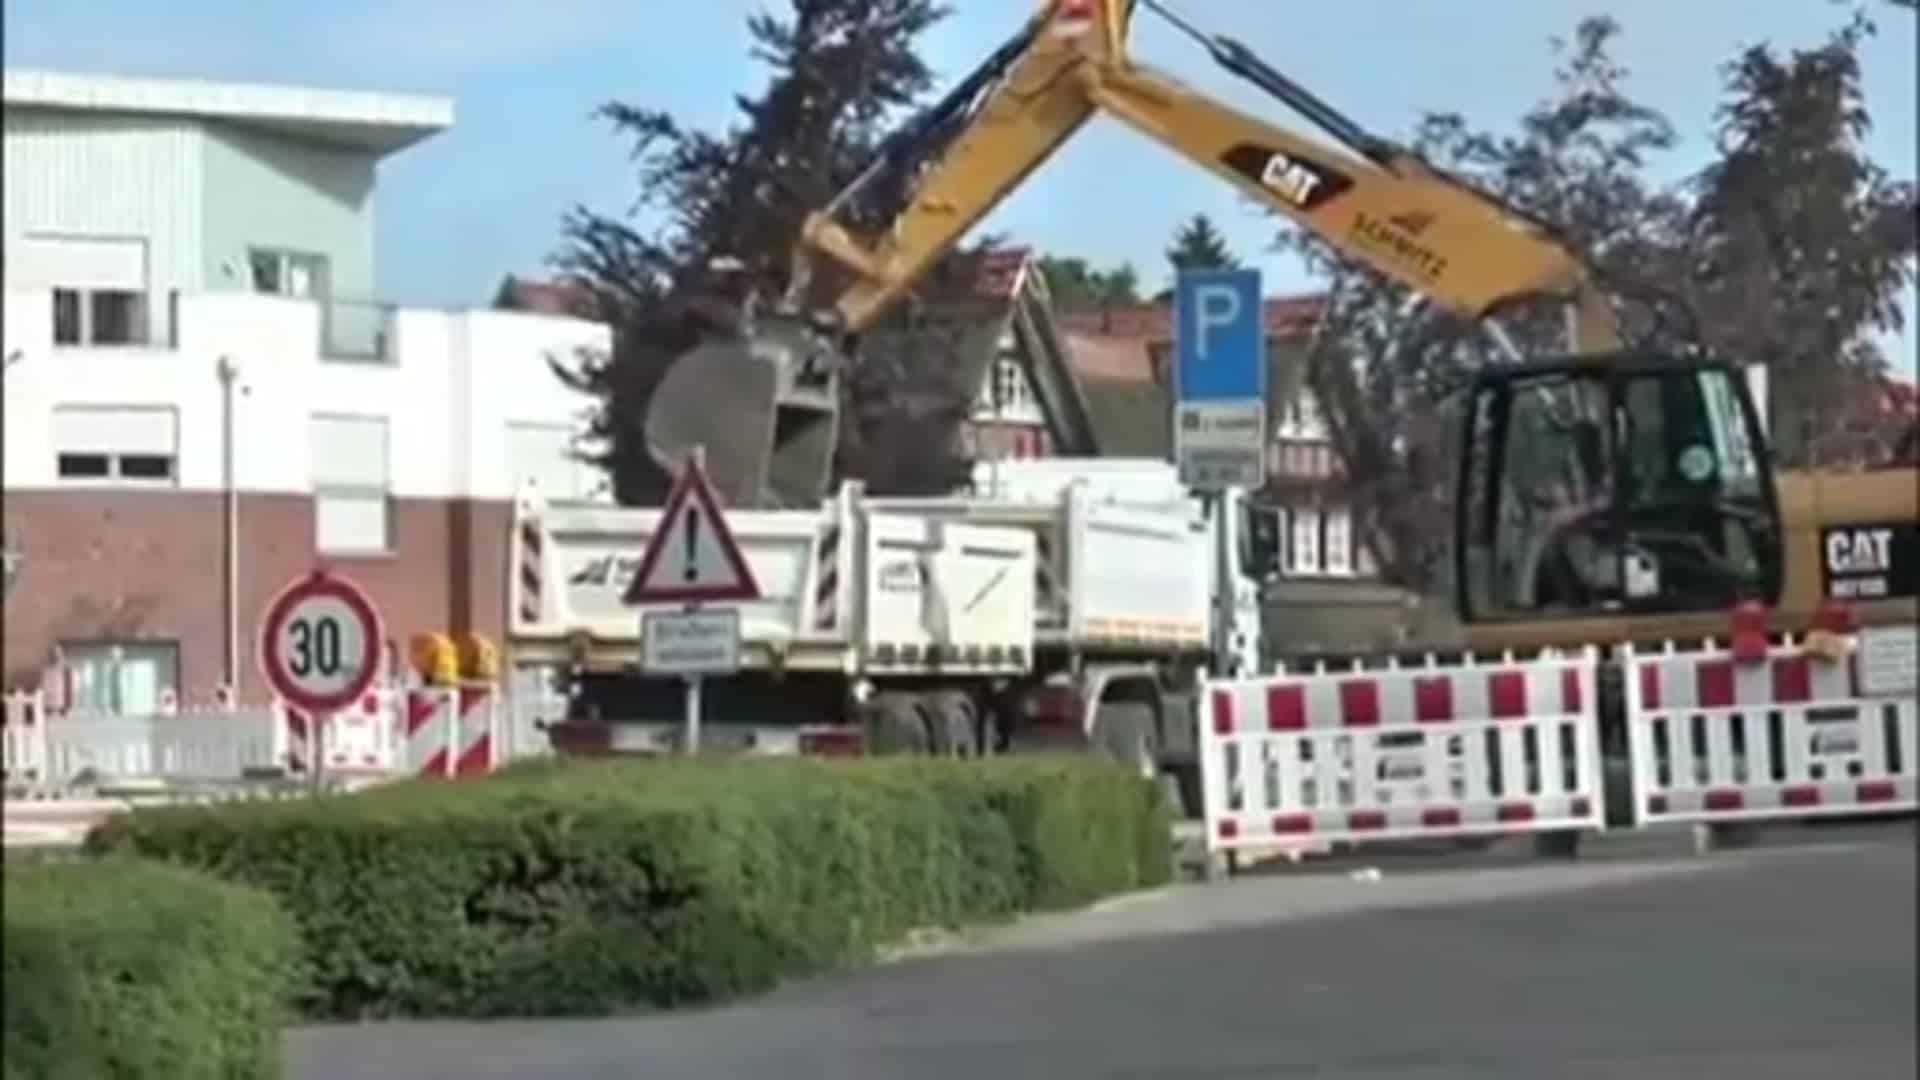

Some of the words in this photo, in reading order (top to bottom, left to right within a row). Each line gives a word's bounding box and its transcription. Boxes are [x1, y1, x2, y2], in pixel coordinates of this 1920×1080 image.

[1261, 153, 1321, 204] CAT
[1196, 284, 1241, 360] P
[1826, 530, 1894, 572] CAT
[288, 617, 341, 677] 30
